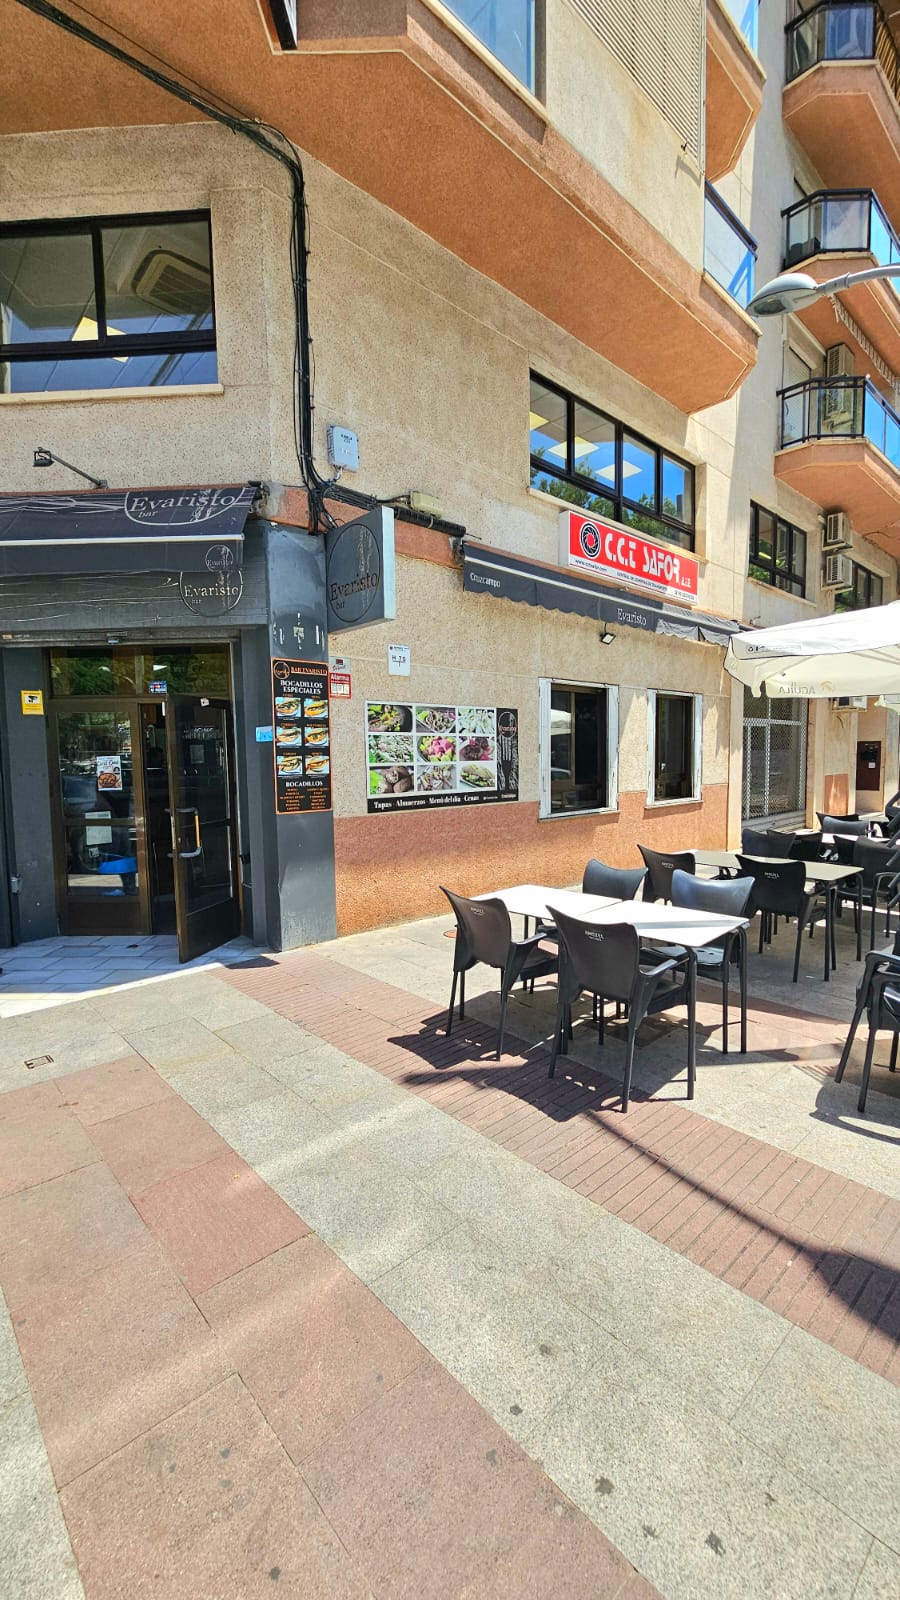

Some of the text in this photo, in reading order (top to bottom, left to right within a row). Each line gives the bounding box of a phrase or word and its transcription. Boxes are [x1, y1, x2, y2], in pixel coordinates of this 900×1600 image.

[130, 492, 235, 512] Evaristo
[138, 510, 158, 518] bar
[469, 572, 501, 588] Cruzcampo
[184, 583, 239, 597] Evaristo
[330, 572, 379, 601] Evaristo
[617, 607, 647, 626] Evaristo
[280, 680, 323, 689] BOCADILLOS
[283, 687, 321, 695] ESPECIALES
[285, 780, 323, 788] BOCADILLOS
[374, 801, 392, 810] Tapas
[396, 799, 426, 807] Almuerzos
